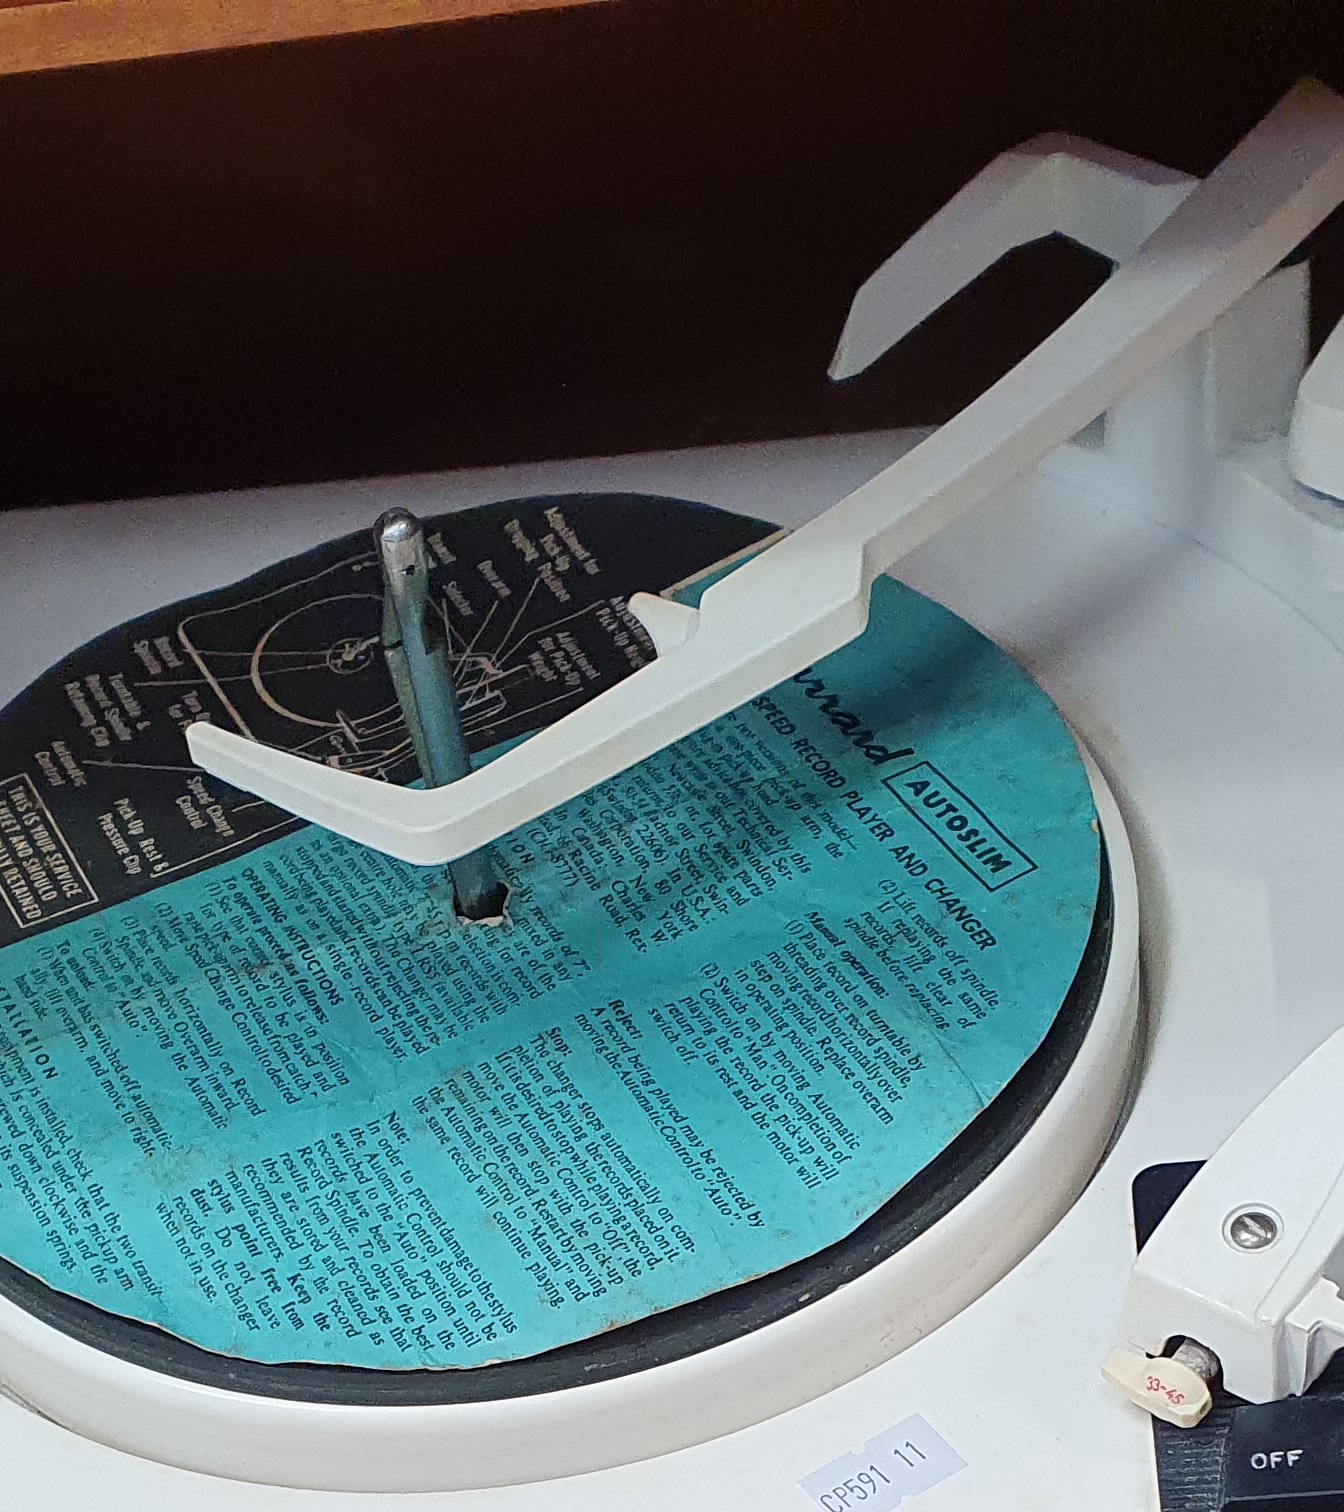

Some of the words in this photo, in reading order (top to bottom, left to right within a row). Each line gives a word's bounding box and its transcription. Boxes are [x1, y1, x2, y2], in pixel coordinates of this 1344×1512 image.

[7, 784, 33, 812] THIS
[21, 811, 40, 826] IS
[29, 823, 56, 853] YOUR
[96, 811, 130, 856] Pressure
[903, 779, 1012, 874] AUTOSLIM
[8, 834, 33, 858] AND
[21, 857, 57, 901] SHOULD
[43, 852, 83, 898] SERVICE
[137, 836, 163, 862] Rest
[789, 737, 846, 788] RECORD
[837, 789, 895, 842] PLAYER
[887, 844, 928, 877] AND
[923, 877, 997, 951] CHANGER
[1, 866, 42, 919] RETAINED
[240, 866, 288, 923] OPERATING
[280, 924, 344, 1006] INSTRUCTIONS
[610, 879, 647, 922] Charles
[628, 873, 657, 902] New
[656, 909, 684, 940] York
[668, 898, 699, 932] Shore
[891, 890, 917, 915] Lift
[910, 913, 949, 948] records
[943, 949, 969, 967] off
[203, 967, 235, 1011] Change
[231, 1011, 269, 1056] Control
[796, 930, 826, 961] Place
[821, 960, 859, 994] record
[851, 993, 869, 1009] on
[865, 1008, 911, 1056] turntable
[906, 1051, 927, 1071] by
[890, 917, 936, 965] replaying
[937, 966, 957, 986] the
[956, 991, 987, 1019] same
[151, 987, 178, 1020] move
[172, 1020, 210, 1073] Overarm
[172, 986, 224, 1057] horizontally
[218, 1060, 235, 1077] on
[229, 1076, 267, 1117] Record
[268, 970, 297, 1008] stylus
[310, 1040, 350, 1086] position
[543, 1026, 573, 1057] Stop:
[607, 998, 643, 1040] Reject:
[646, 1007, 681, 1044] switch
[675, 1045, 699, 1066] off.
[712, 975, 749, 1015] Switch
[744, 1016, 761, 1032] on
[758, 1030, 777, 1048] by
[771, 1048, 811, 1091] moving
[806, 1092, 861, 1150] Automatic
[749, 959, 773, 983] step
[768, 982, 785, 998] on
[814, 1035, 856, 1080] Replace
[851, 1079, 894, 1125] overarm
[381, 1109, 411, 1145] Note:
[528, 1032, 550, 1058] The
[545, 1059, 583, 1100] changer
[576, 1101, 605, 1132] stops
[599, 1131, 662, 1205] automatically
[657, 1206, 674, 1224] on
[669, 1223, 695, 1253] com-
[589, 1007, 606, 1017] A
[599, 1018, 637, 1053] record
[626, 1052, 656, 1087] being
[646, 1087, 689, 1123] played
[678, 1124, 705, 1147] may
[698, 1147, 716, 1165] be
[710, 1165, 756, 1211] rejected
[746, 1209, 765, 1227] by
[6, 1162, 51, 1228] suspension
[45, 1228, 77, 1274] springs.
[17, 1142, 43, 1174] down
[37, 1176, 79, 1236] clockwise
[73, 1237, 99, 1261] and
[89, 1263, 108, 1284] the
[65, 1147, 94, 1182] check
[85, 1182, 111, 1212] that
[102, 1210, 122, 1234] the
[115, 1233, 137, 1259] two
[329, 1131, 373, 1185] switched
[364, 1186, 379, 1200] to
[374, 1201, 394, 1222] the
[414, 1268, 457, 1317] position
[452, 1316, 482, 1348] until
[410, 1094, 429, 1115] the
[424, 1115, 451, 1146] same
[445, 1145, 482, 1184] record
[474, 1184, 499, 1209] will
[491, 1210, 532, 1260] continue
[523, 1260, 565, 1309] playing.
[189, 1187, 214, 1217] dust.
[213, 1225, 232, 1248] Do
[232, 1260, 256, 1285] not
[253, 1294, 281, 1329] leave
[206, 1178, 235, 1214] stylus
[230, 1222, 263, 1258] point
[259, 1266, 282, 1294] free
[280, 1300, 305, 1331] from
[224, 1169, 284, 1263] manufacturers.
[285, 1271, 312, 1305] Keep
[311, 1311, 331, 1332] the
[295, 1145, 333, 1190] Record
[323, 1188, 360, 1238] Spindle.
[356, 1237, 374, 1259] To
[369, 1262, 400, 1301] obtain
[395, 1302, 415, 1324] the
[410, 1323, 435, 1351] best
[1145, 1375, 1185, 1405] 33-45
[893, 1440, 927, 1468] 11
[1250, 1449, 1304, 1470] OFF
